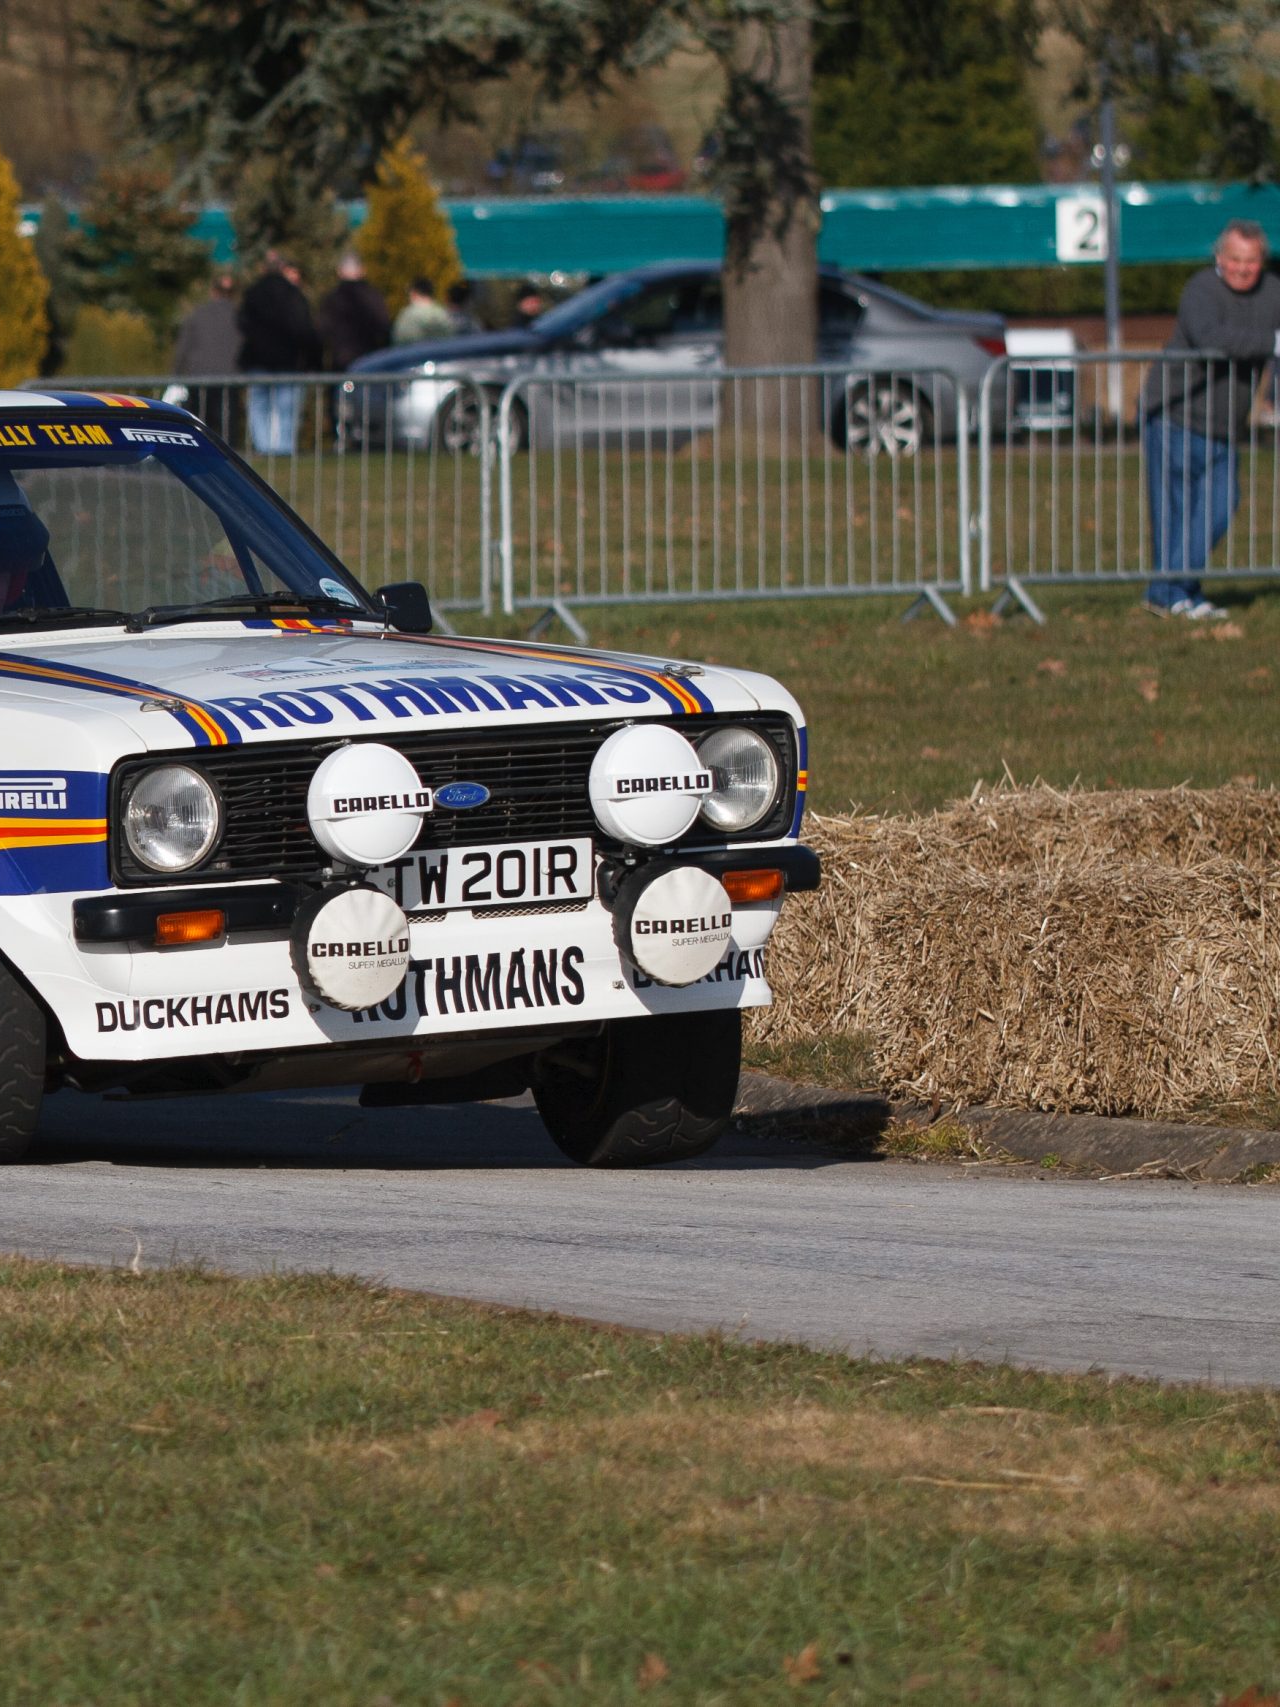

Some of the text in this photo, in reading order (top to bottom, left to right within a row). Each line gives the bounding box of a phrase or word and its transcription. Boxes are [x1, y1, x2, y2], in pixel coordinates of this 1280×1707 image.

[1075, 208, 1098, 251] 2
[38, 424, 113, 446] TEAM
[120, 427, 199, 448] PIRELLI
[205, 674, 650, 730] ROTHMANS
[617, 774, 710, 794] CARELLO
[334, 793, 430, 814] CARELLO
[371, 845, 577, 907] TW 201R
[635, 913, 732, 935] CARELLO
[311, 938, 409, 958] CARELLO
[672, 937, 698, 946] SUPER
[348, 957, 407, 969] SUPER MEGALUX
[352, 946, 584, 1023] OTHMANS
[95, 988, 290, 1033] DUCKHAMS
